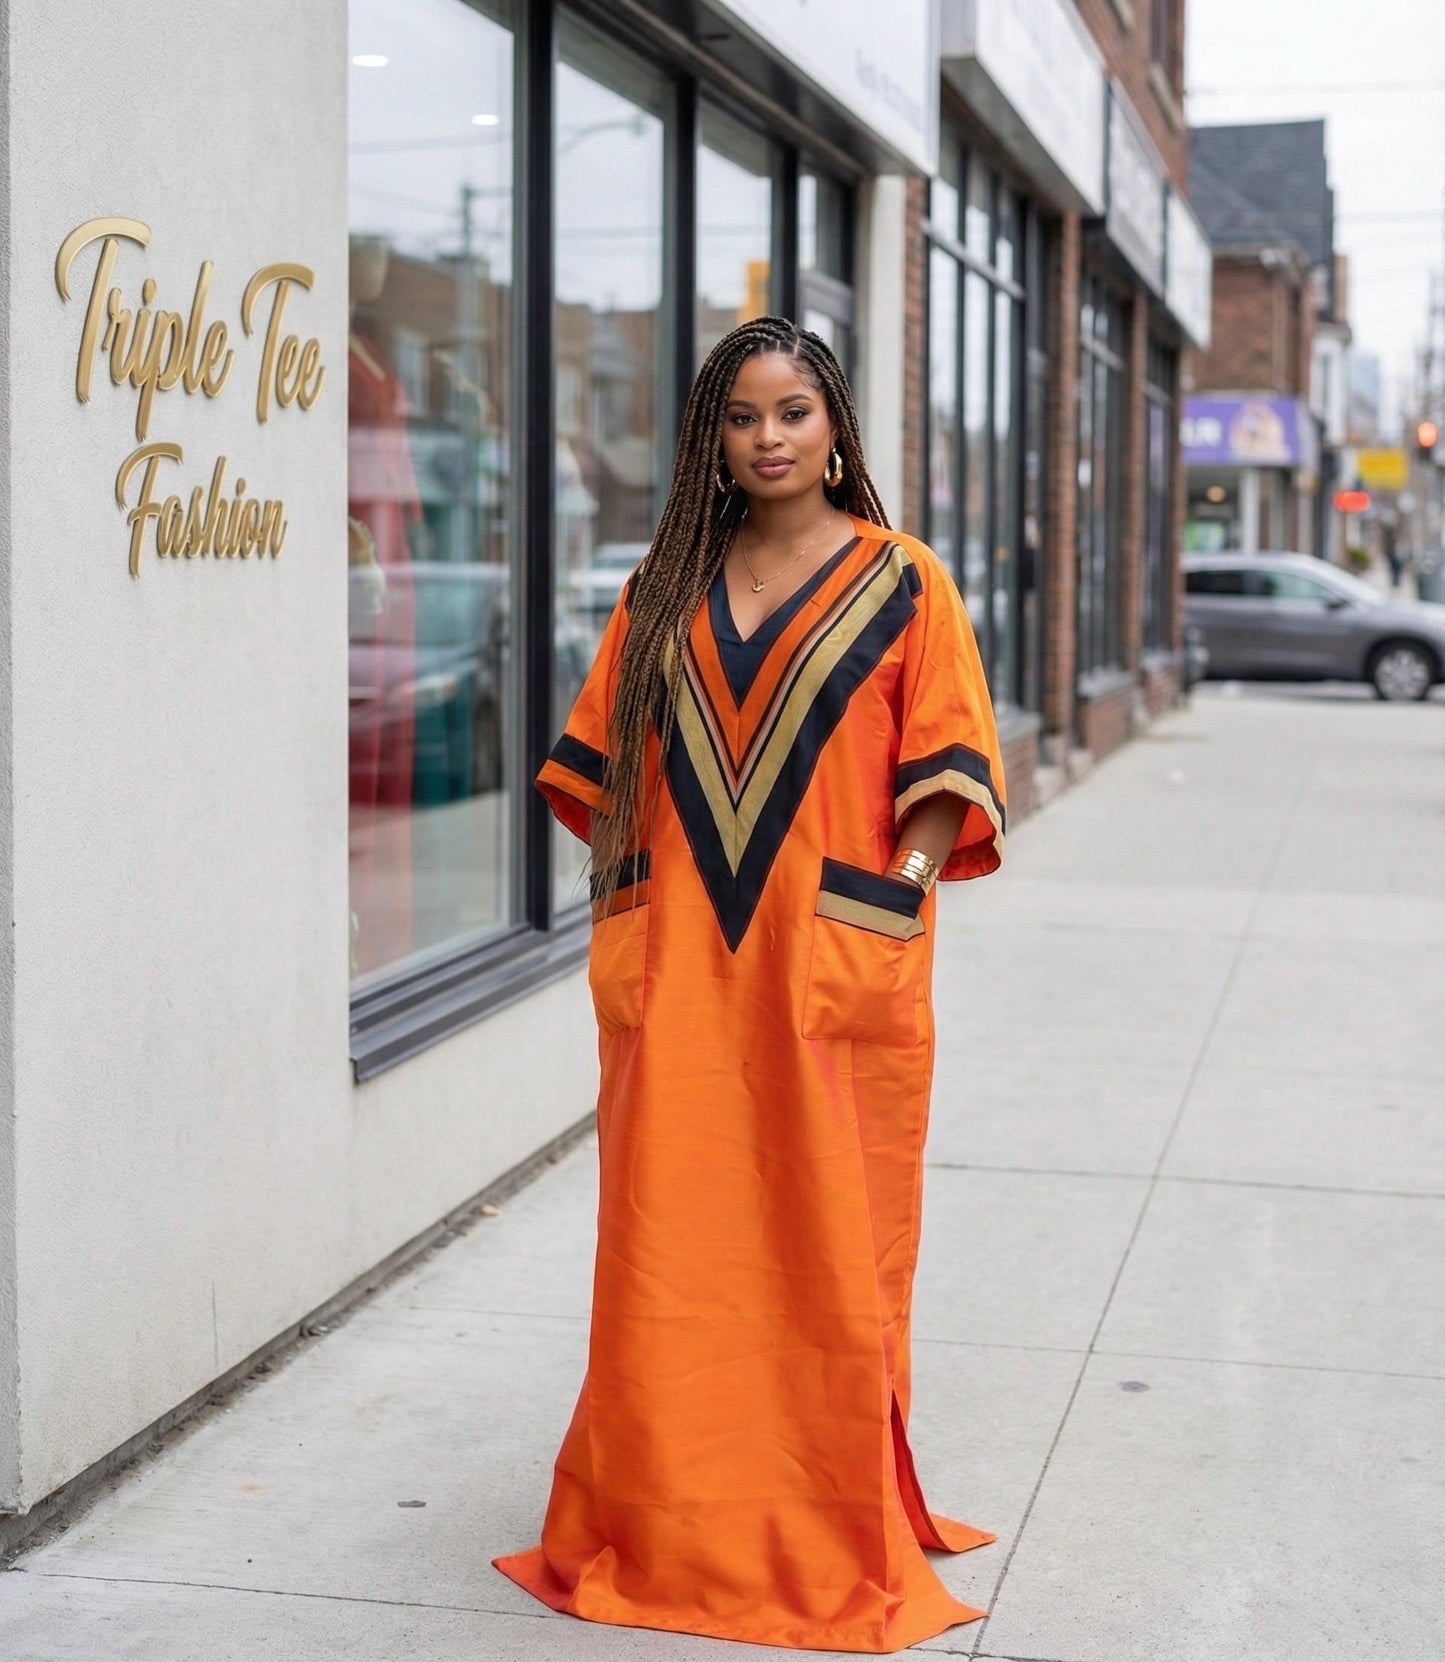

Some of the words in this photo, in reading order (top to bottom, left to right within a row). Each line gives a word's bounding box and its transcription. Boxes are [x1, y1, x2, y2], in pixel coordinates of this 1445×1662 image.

[55, 217, 234, 440] Triple
[241, 263, 325, 424] Tee
[115, 442, 287, 577] Fashion
